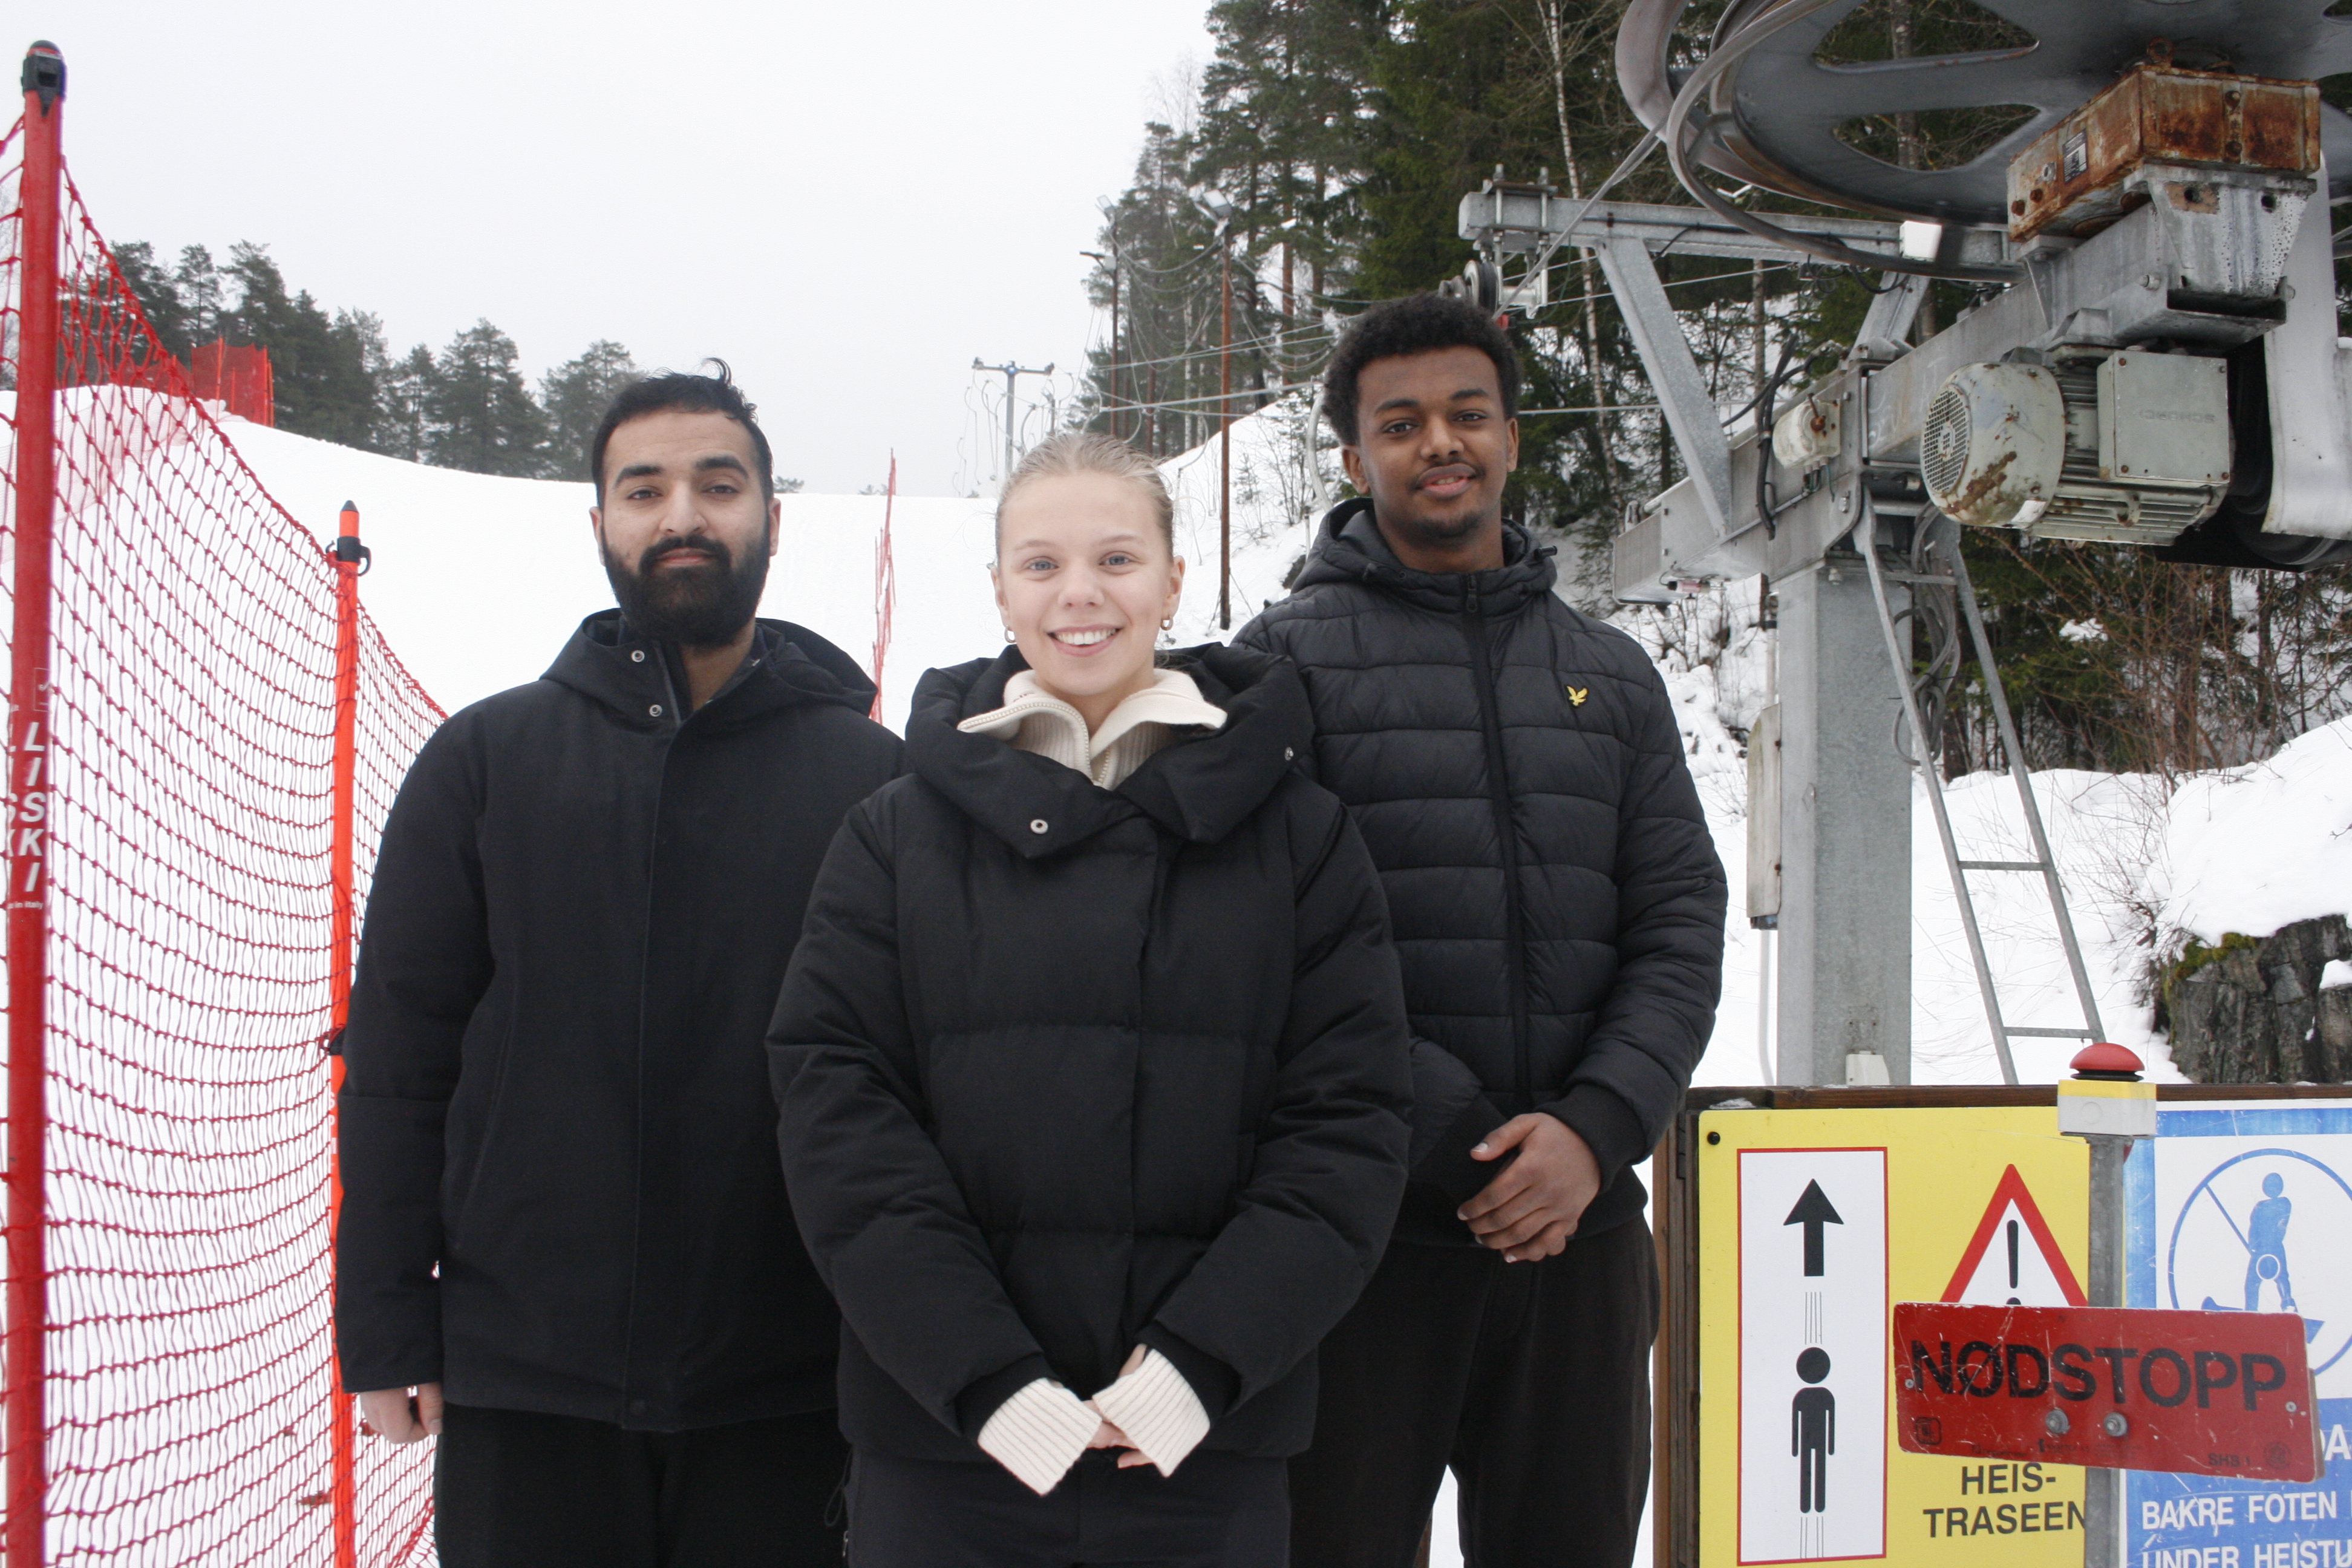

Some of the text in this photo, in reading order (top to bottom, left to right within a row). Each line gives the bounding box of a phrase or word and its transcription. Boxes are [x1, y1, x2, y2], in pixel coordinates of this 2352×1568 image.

[19, 722, 47, 892] LISKI
[1910, 1339, 2287, 1411] NØDSTOPP
[1961, 1462, 2056, 1495] HEIS-
[1922, 1500, 2085, 1538] TRASEEN
[2142, 1496, 2235, 1530] BAKRE
[2248, 1490, 2337, 1523] FOTEN
[2142, 1546, 2239, 1568] UNDER
